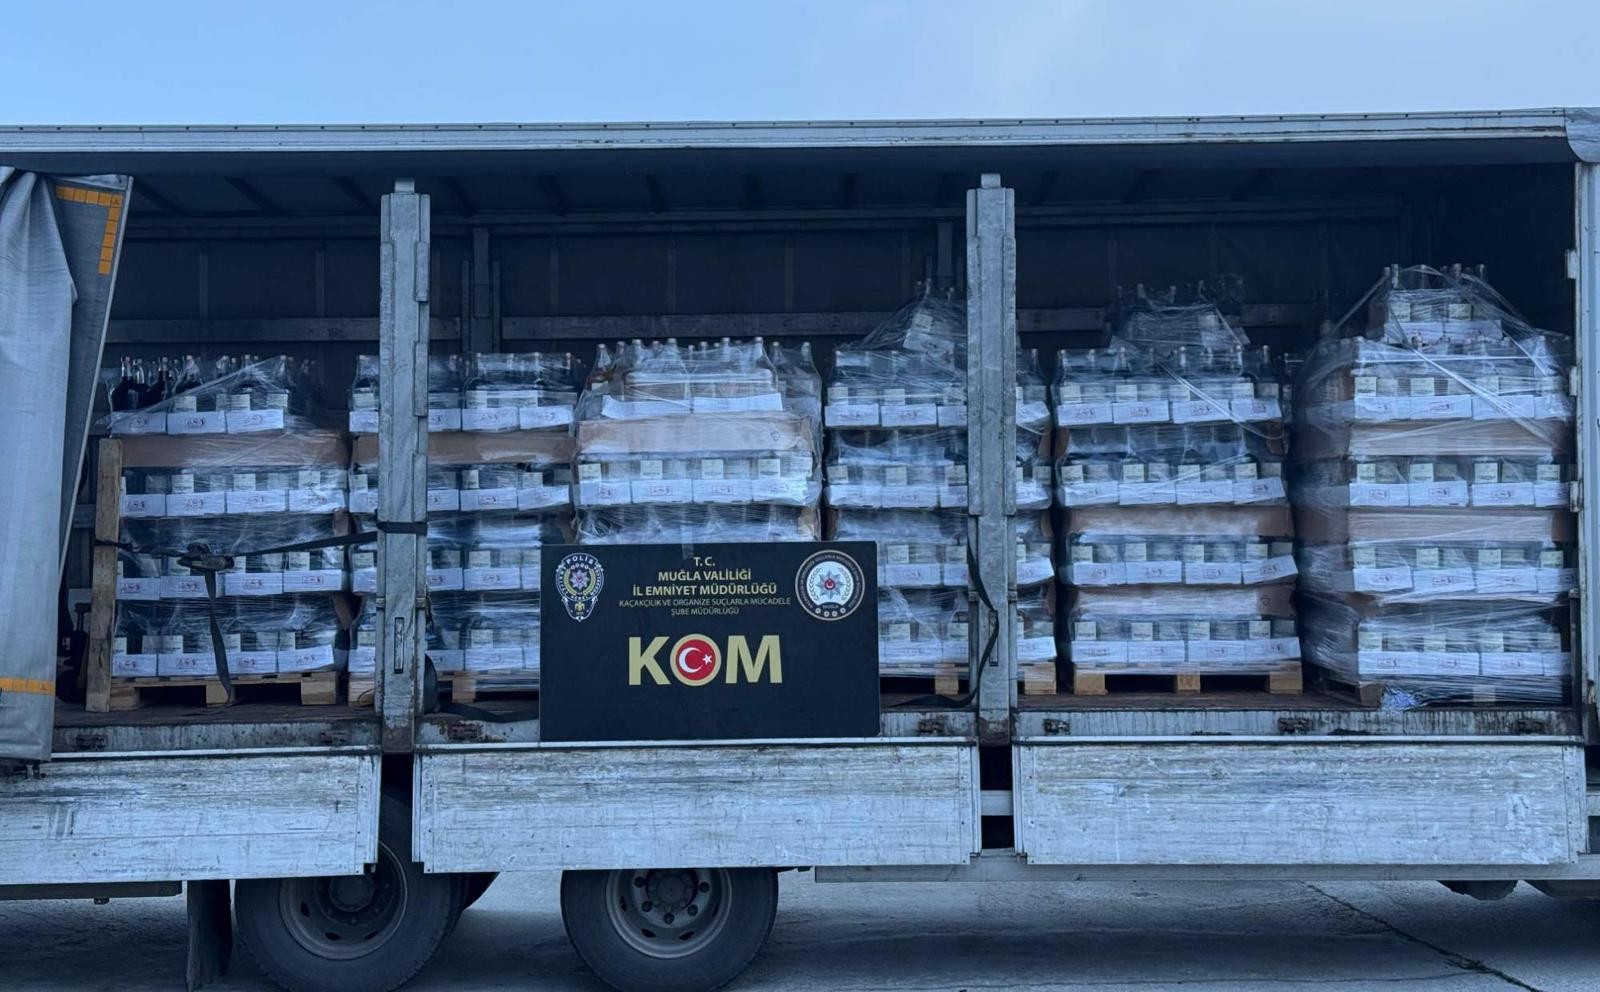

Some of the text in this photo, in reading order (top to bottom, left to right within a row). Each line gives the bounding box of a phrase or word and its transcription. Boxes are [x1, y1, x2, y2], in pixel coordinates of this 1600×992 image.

[658, 567, 752, 581] MUĞLA VALİLİĞİ
[632, 582, 777, 596] İL EMNİYET MÜDÜRLÜĞÜ
[662, 599, 672, 607] VE
[673, 597, 710, 607] ORGANİZE
[712, 598, 749, 607] SUÇLARLA
[750, 596, 791, 606] MÜCADELE
[671, 606, 740, 617] ŞUBE MÜDÜRLÜĞÜ
[628, 633, 783, 687] KOM
